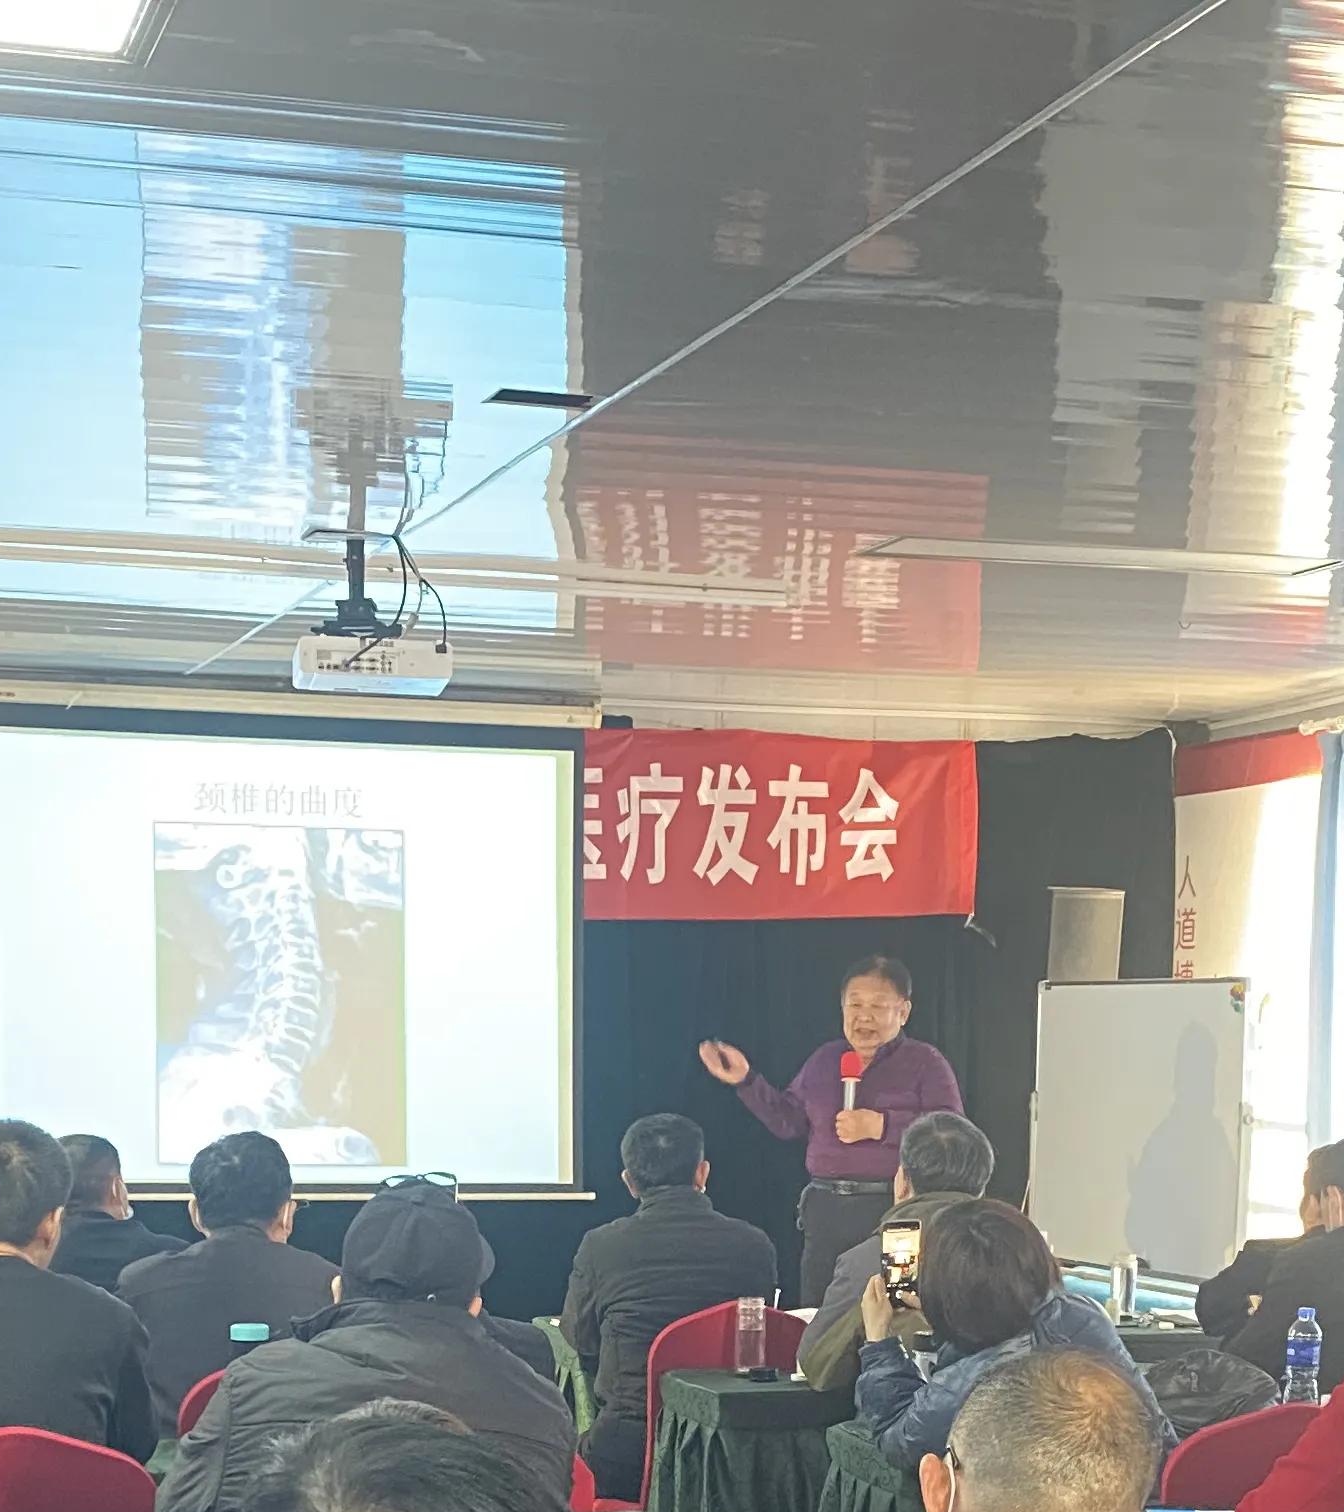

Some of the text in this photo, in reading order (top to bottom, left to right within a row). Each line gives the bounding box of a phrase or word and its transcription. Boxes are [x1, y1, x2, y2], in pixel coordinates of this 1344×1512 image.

[193, 782, 362, 818] 颈椎的曲度
